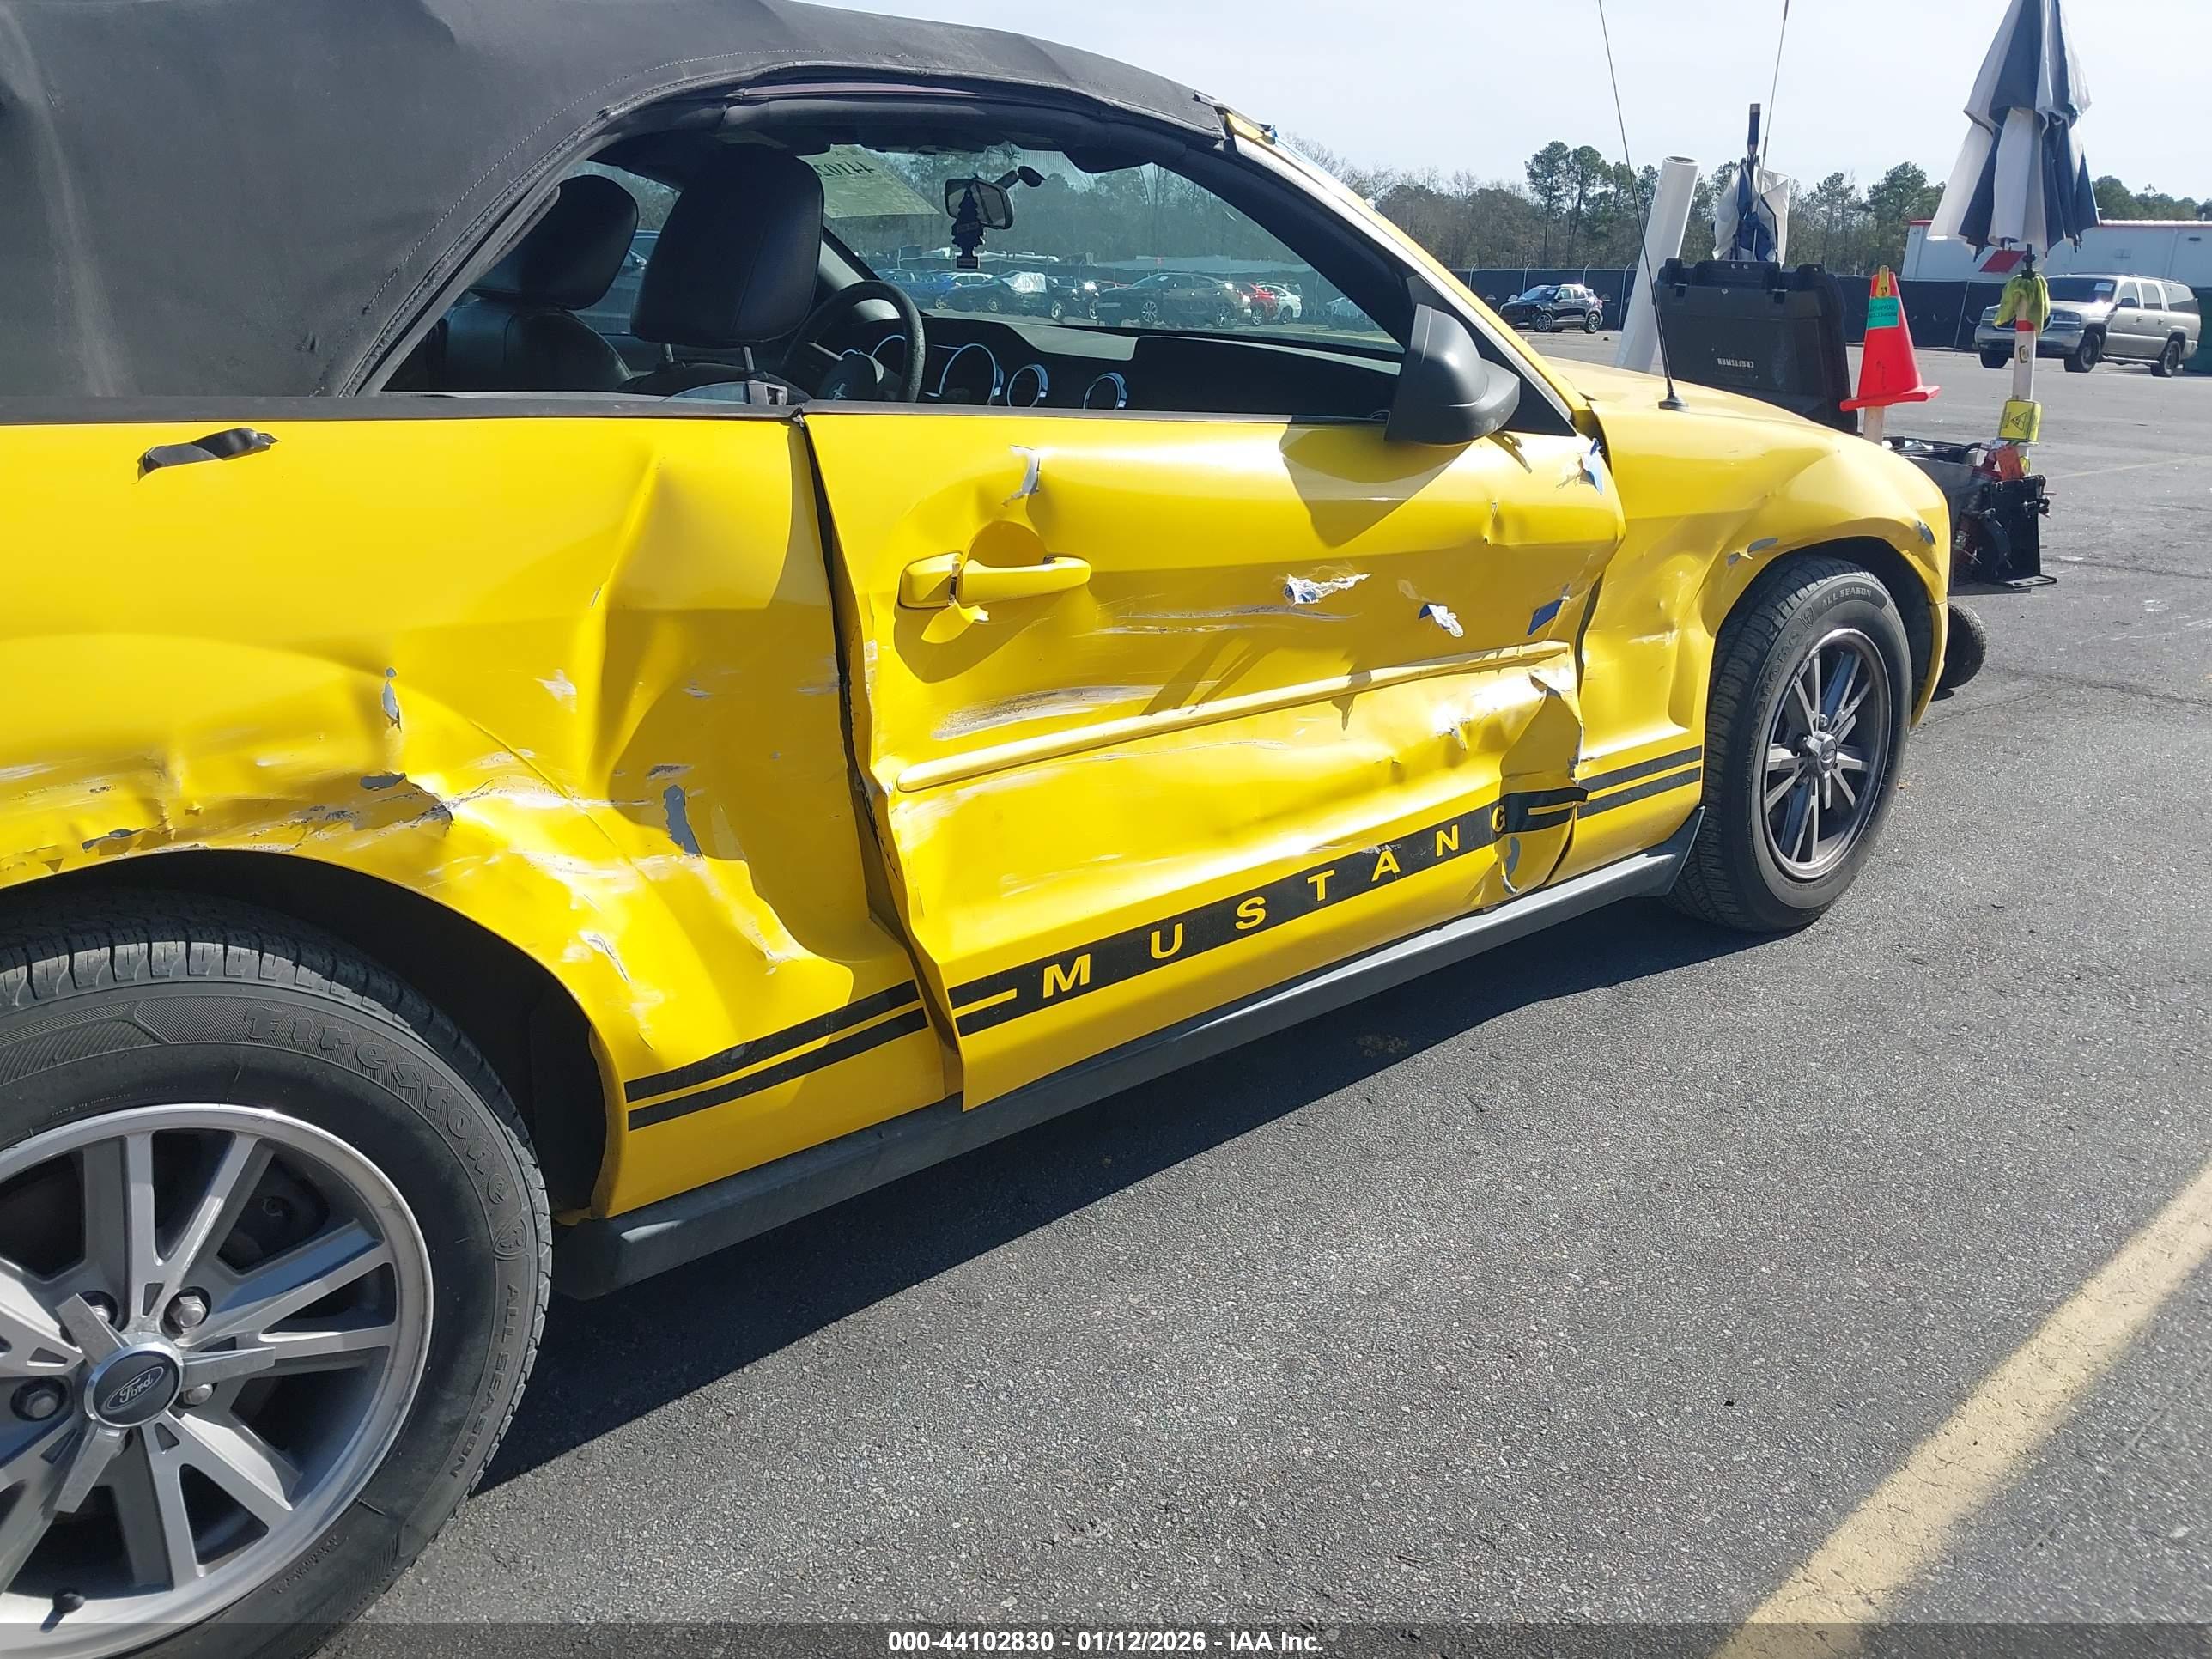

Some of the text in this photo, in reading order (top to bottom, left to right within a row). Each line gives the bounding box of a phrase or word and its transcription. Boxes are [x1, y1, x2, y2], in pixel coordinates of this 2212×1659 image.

[1822, 587, 1872, 606] ALL SEASON
[1042, 805, 1505, 998] MUSTANG
[245, 1006, 509, 1204] Firestone
[119, 1374, 153, 1404] Ford
[449, 1284, 520, 1479] ALL SEASON
